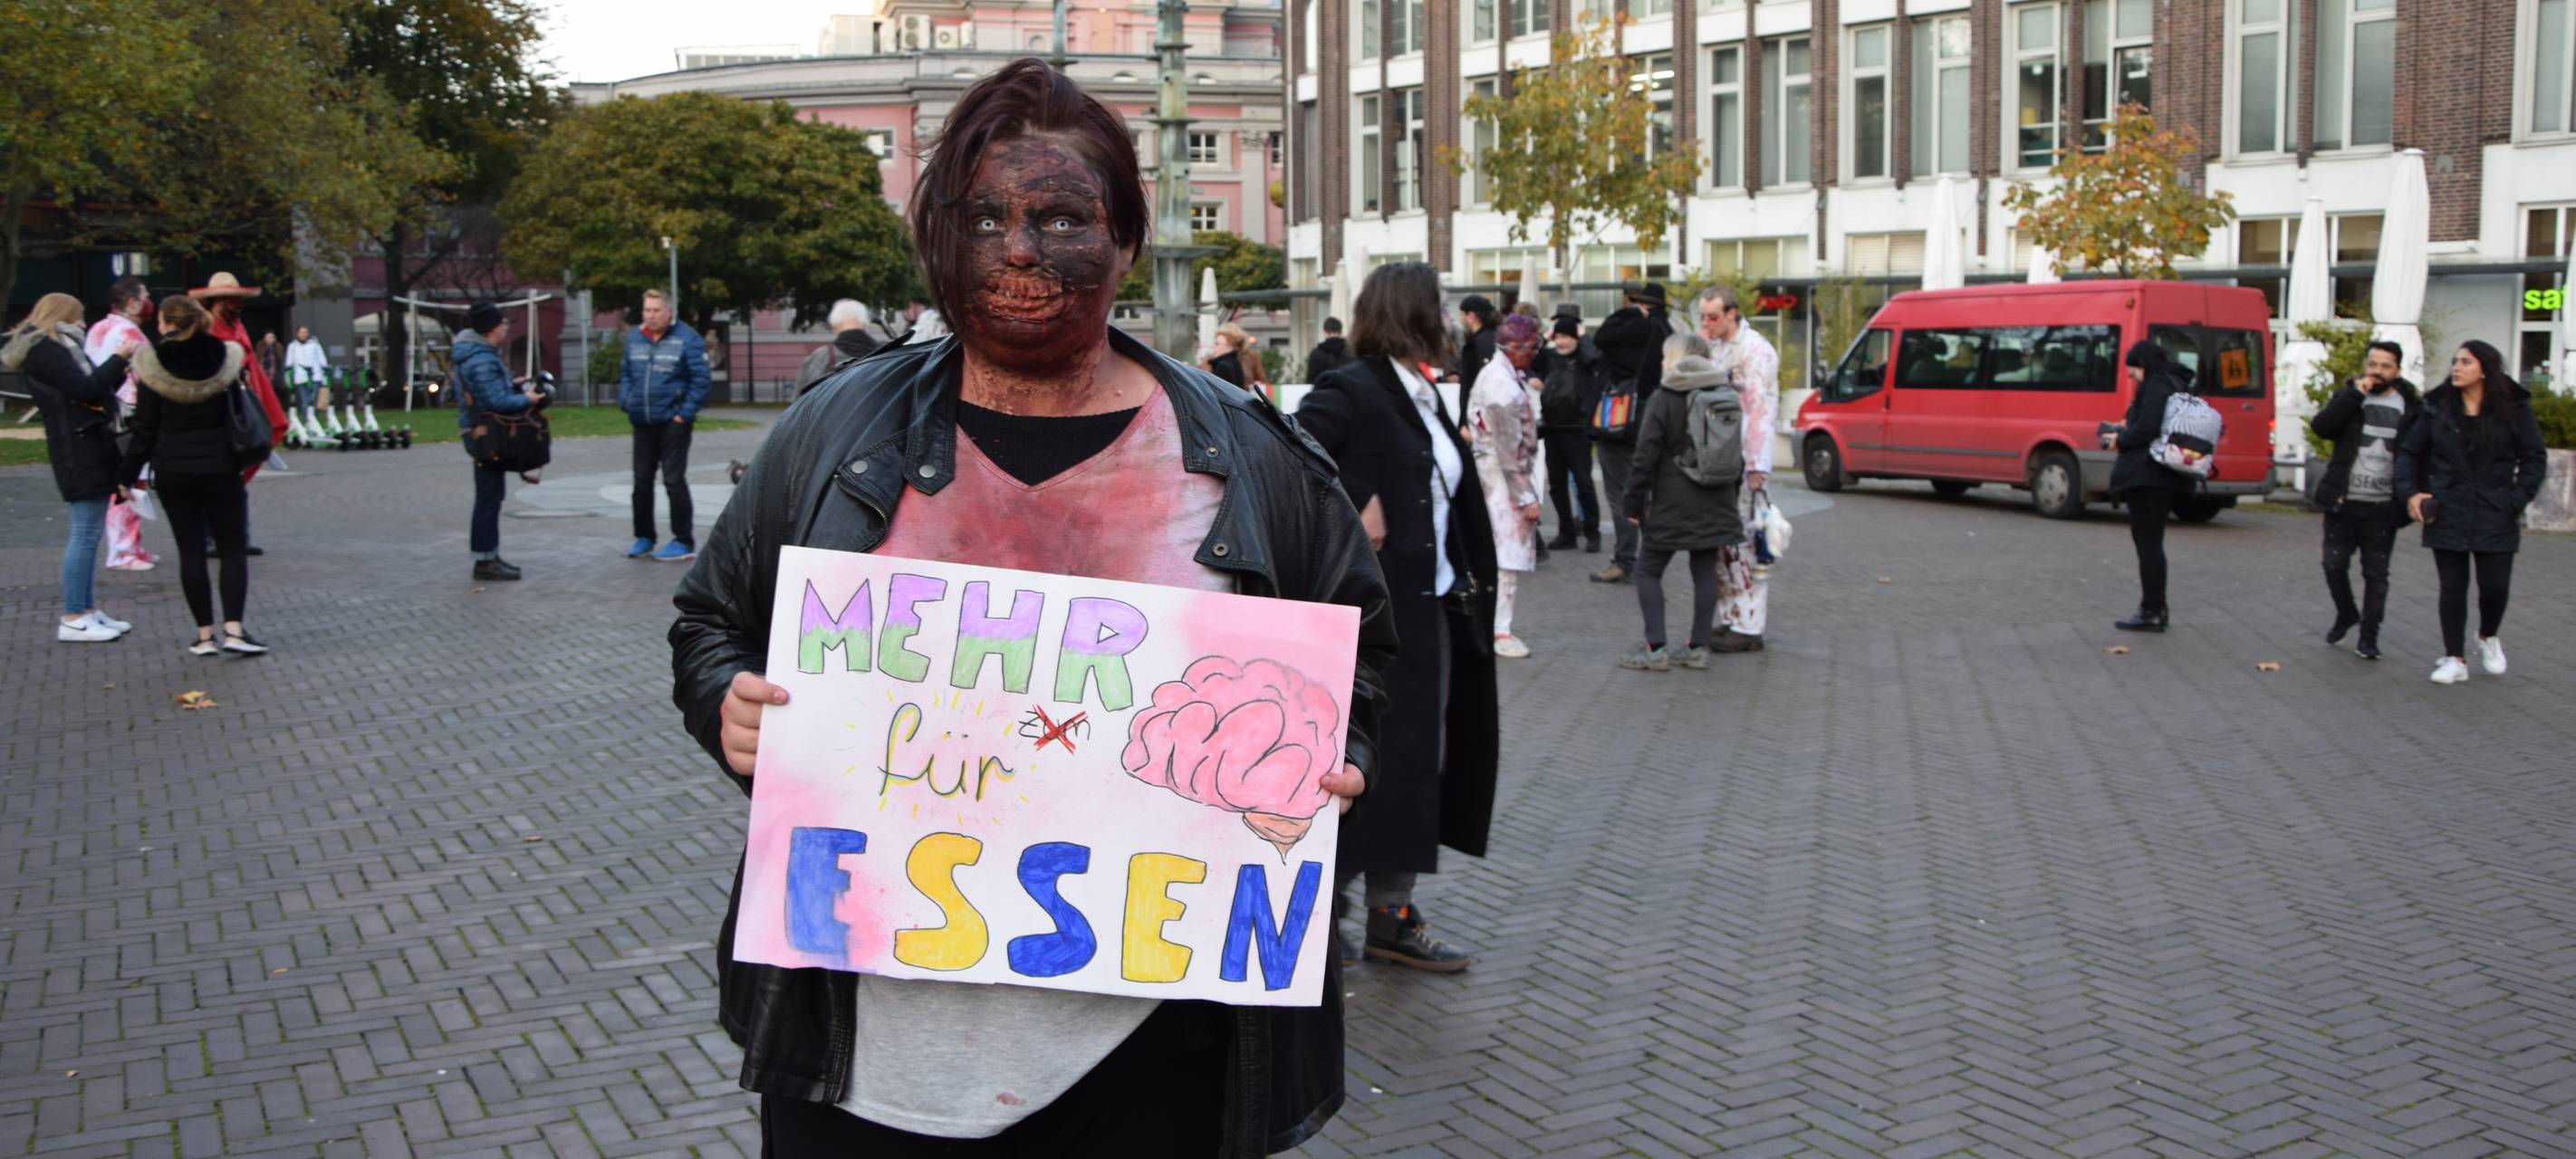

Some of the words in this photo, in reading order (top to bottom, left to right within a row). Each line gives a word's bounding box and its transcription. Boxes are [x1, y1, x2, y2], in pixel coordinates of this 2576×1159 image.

[796, 573, 1149, 712] MEHR
[878, 703, 1015, 801] für
[784, 826, 1323, 991] ESSEN
